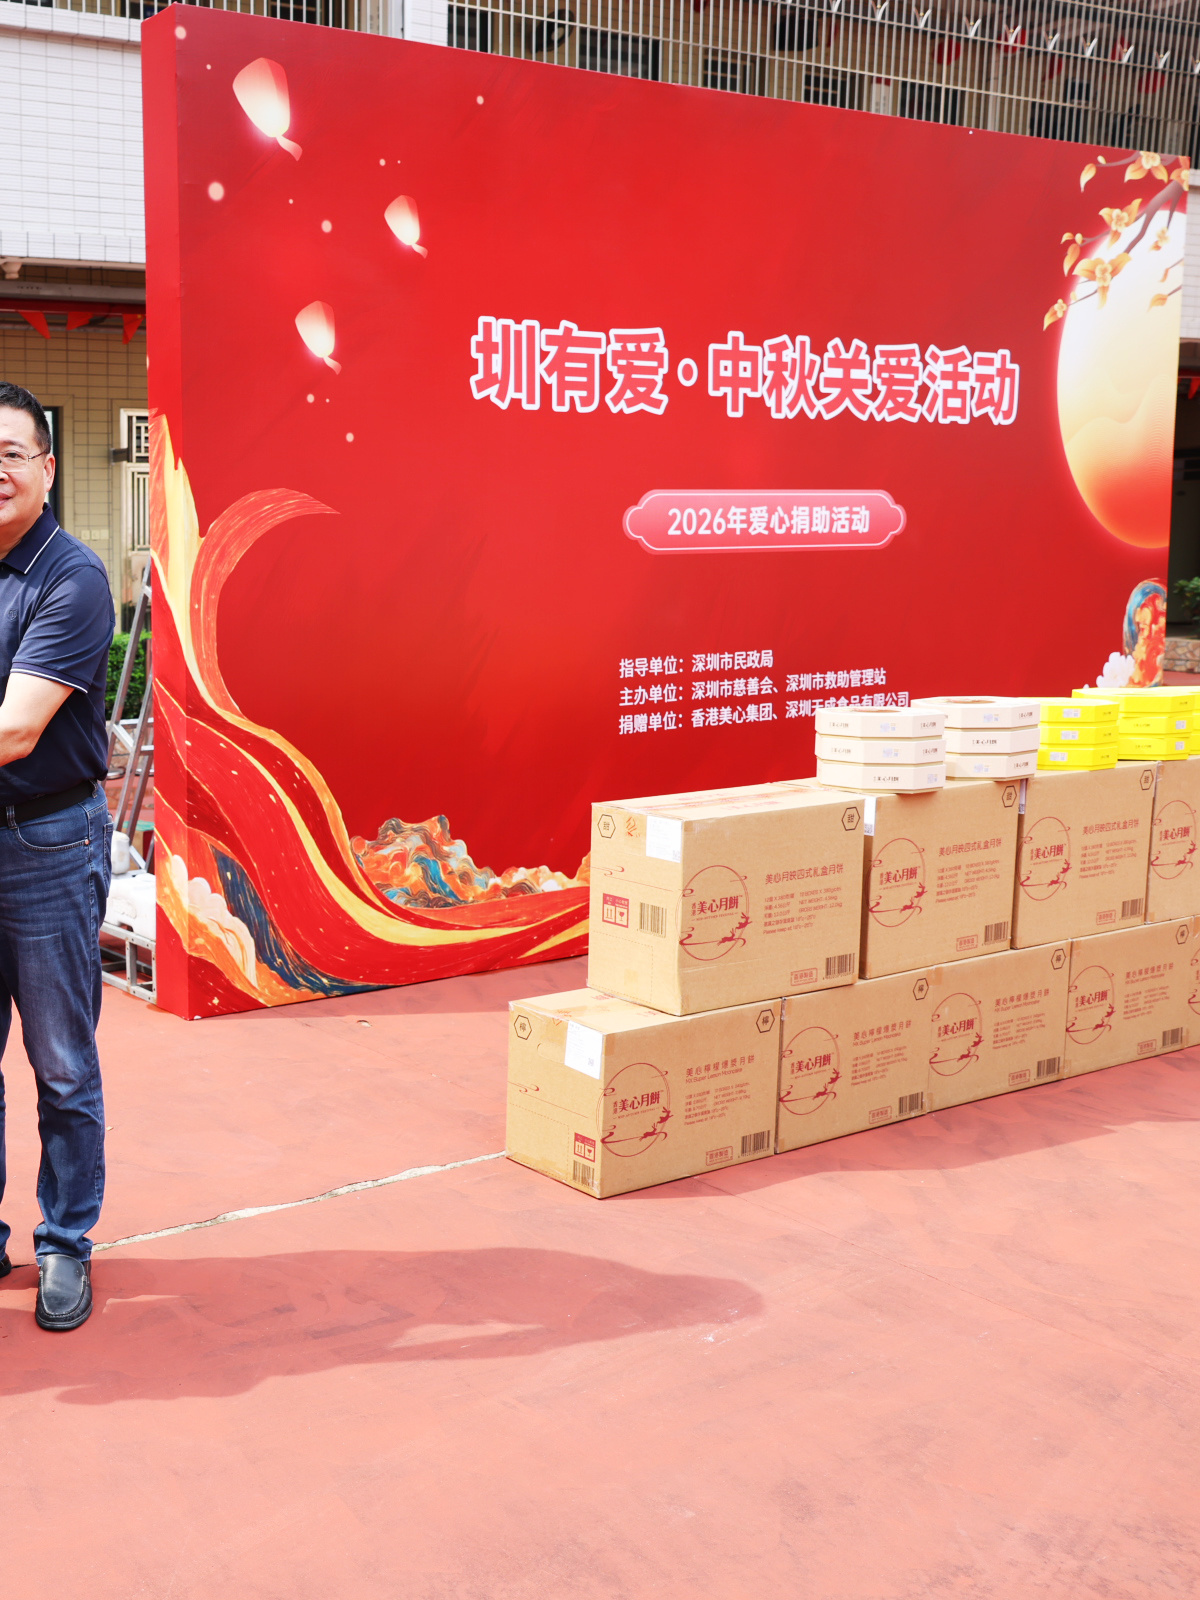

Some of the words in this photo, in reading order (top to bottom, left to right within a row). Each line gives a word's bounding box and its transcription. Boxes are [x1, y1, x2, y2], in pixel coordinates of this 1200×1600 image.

[667, 505, 870, 535] 2026年爱心捐助活动
[696, 896, 738, 914] 美心月餅
[796, 1054, 832, 1073] 美心月餅
[619, 1091, 660, 1112] 美心月餅
